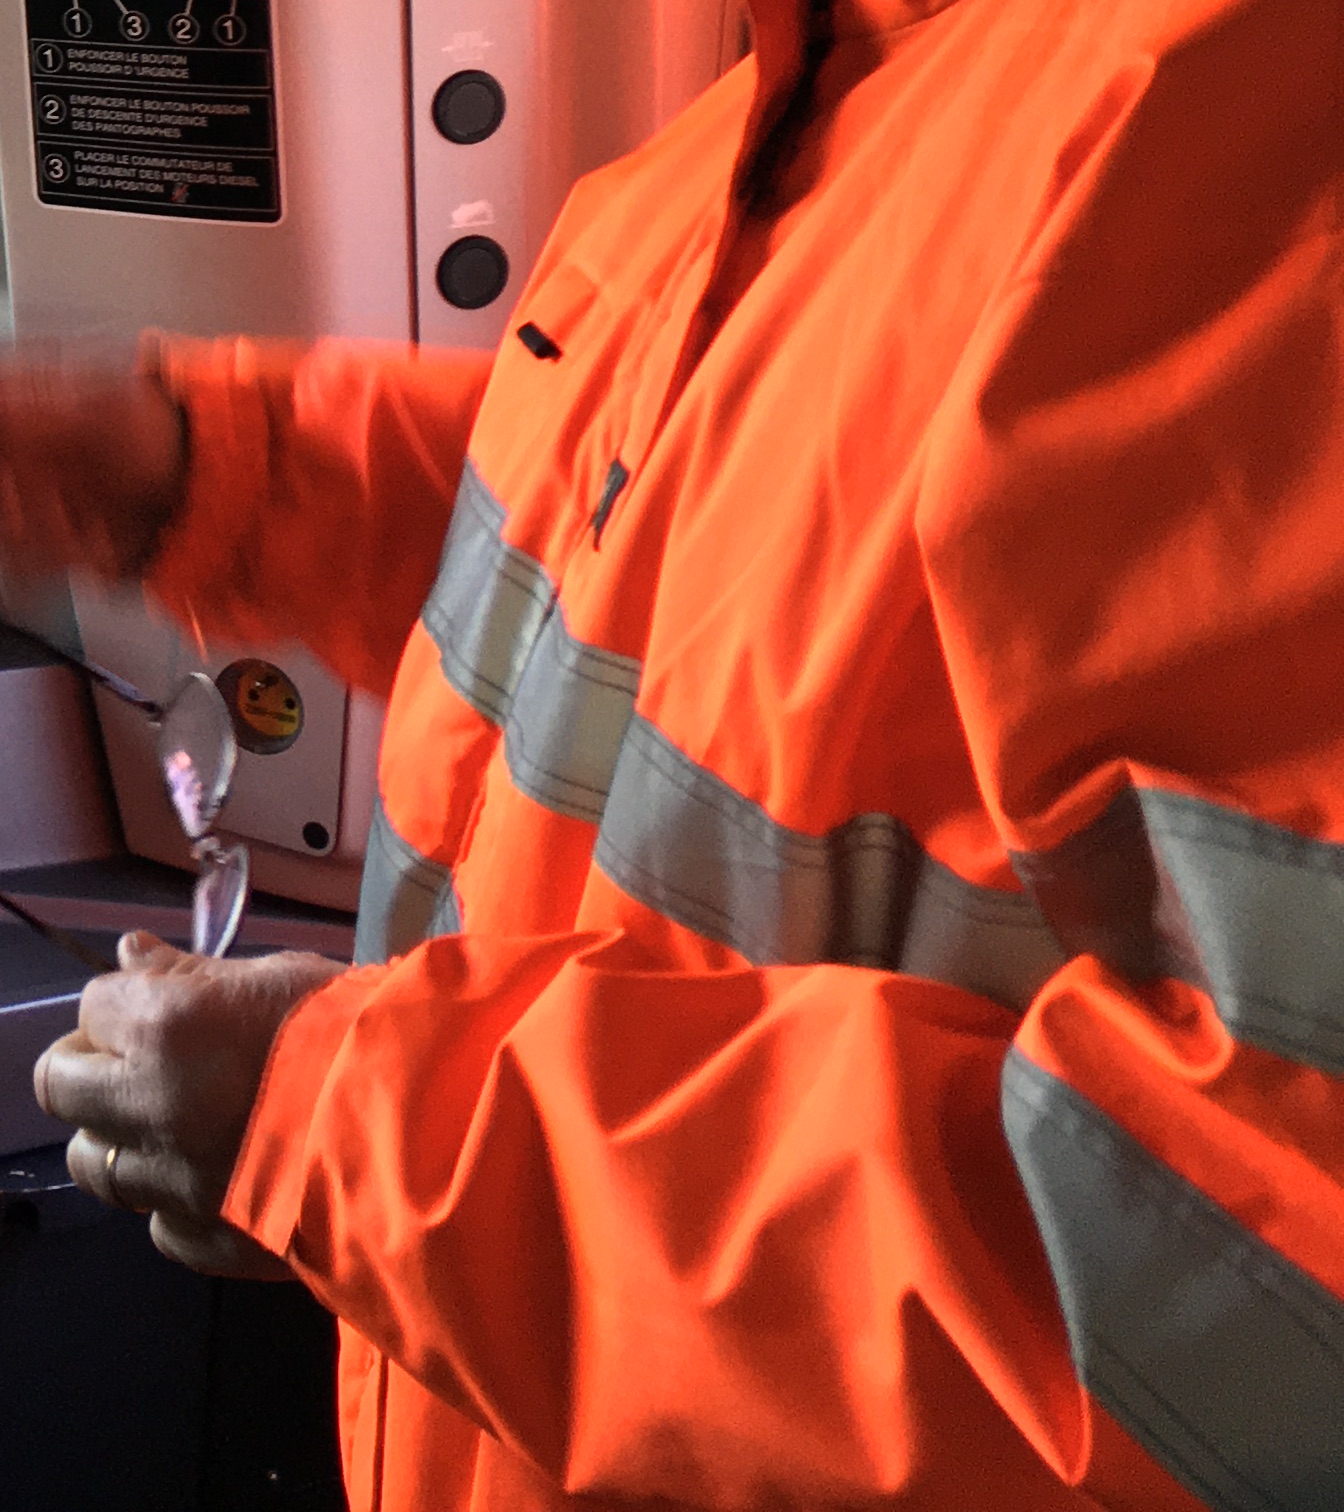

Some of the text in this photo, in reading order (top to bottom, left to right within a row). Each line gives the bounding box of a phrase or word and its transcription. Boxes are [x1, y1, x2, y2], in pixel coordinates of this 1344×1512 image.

[126, 15, 142, 36] 3
[175, 19, 192, 39] 2
[222, 20, 234, 40] 1
[127, 51, 139, 63] LE
[141, 53, 187, 65] BOUTON
[45, 99, 60, 120] 2
[129, 98, 141, 109] LE
[143, 100, 189, 112] BOUTON
[71, 108, 86, 118] DE
[72, 120, 93, 131] DES
[48, 158, 63, 179] 3
[74, 150, 115, 163] PLACER
[117, 154, 129, 165] LE
[217, 162, 233, 172] DE
[139, 169, 161, 180] DES
[76, 176, 164, 193] SUR LA POSITION
